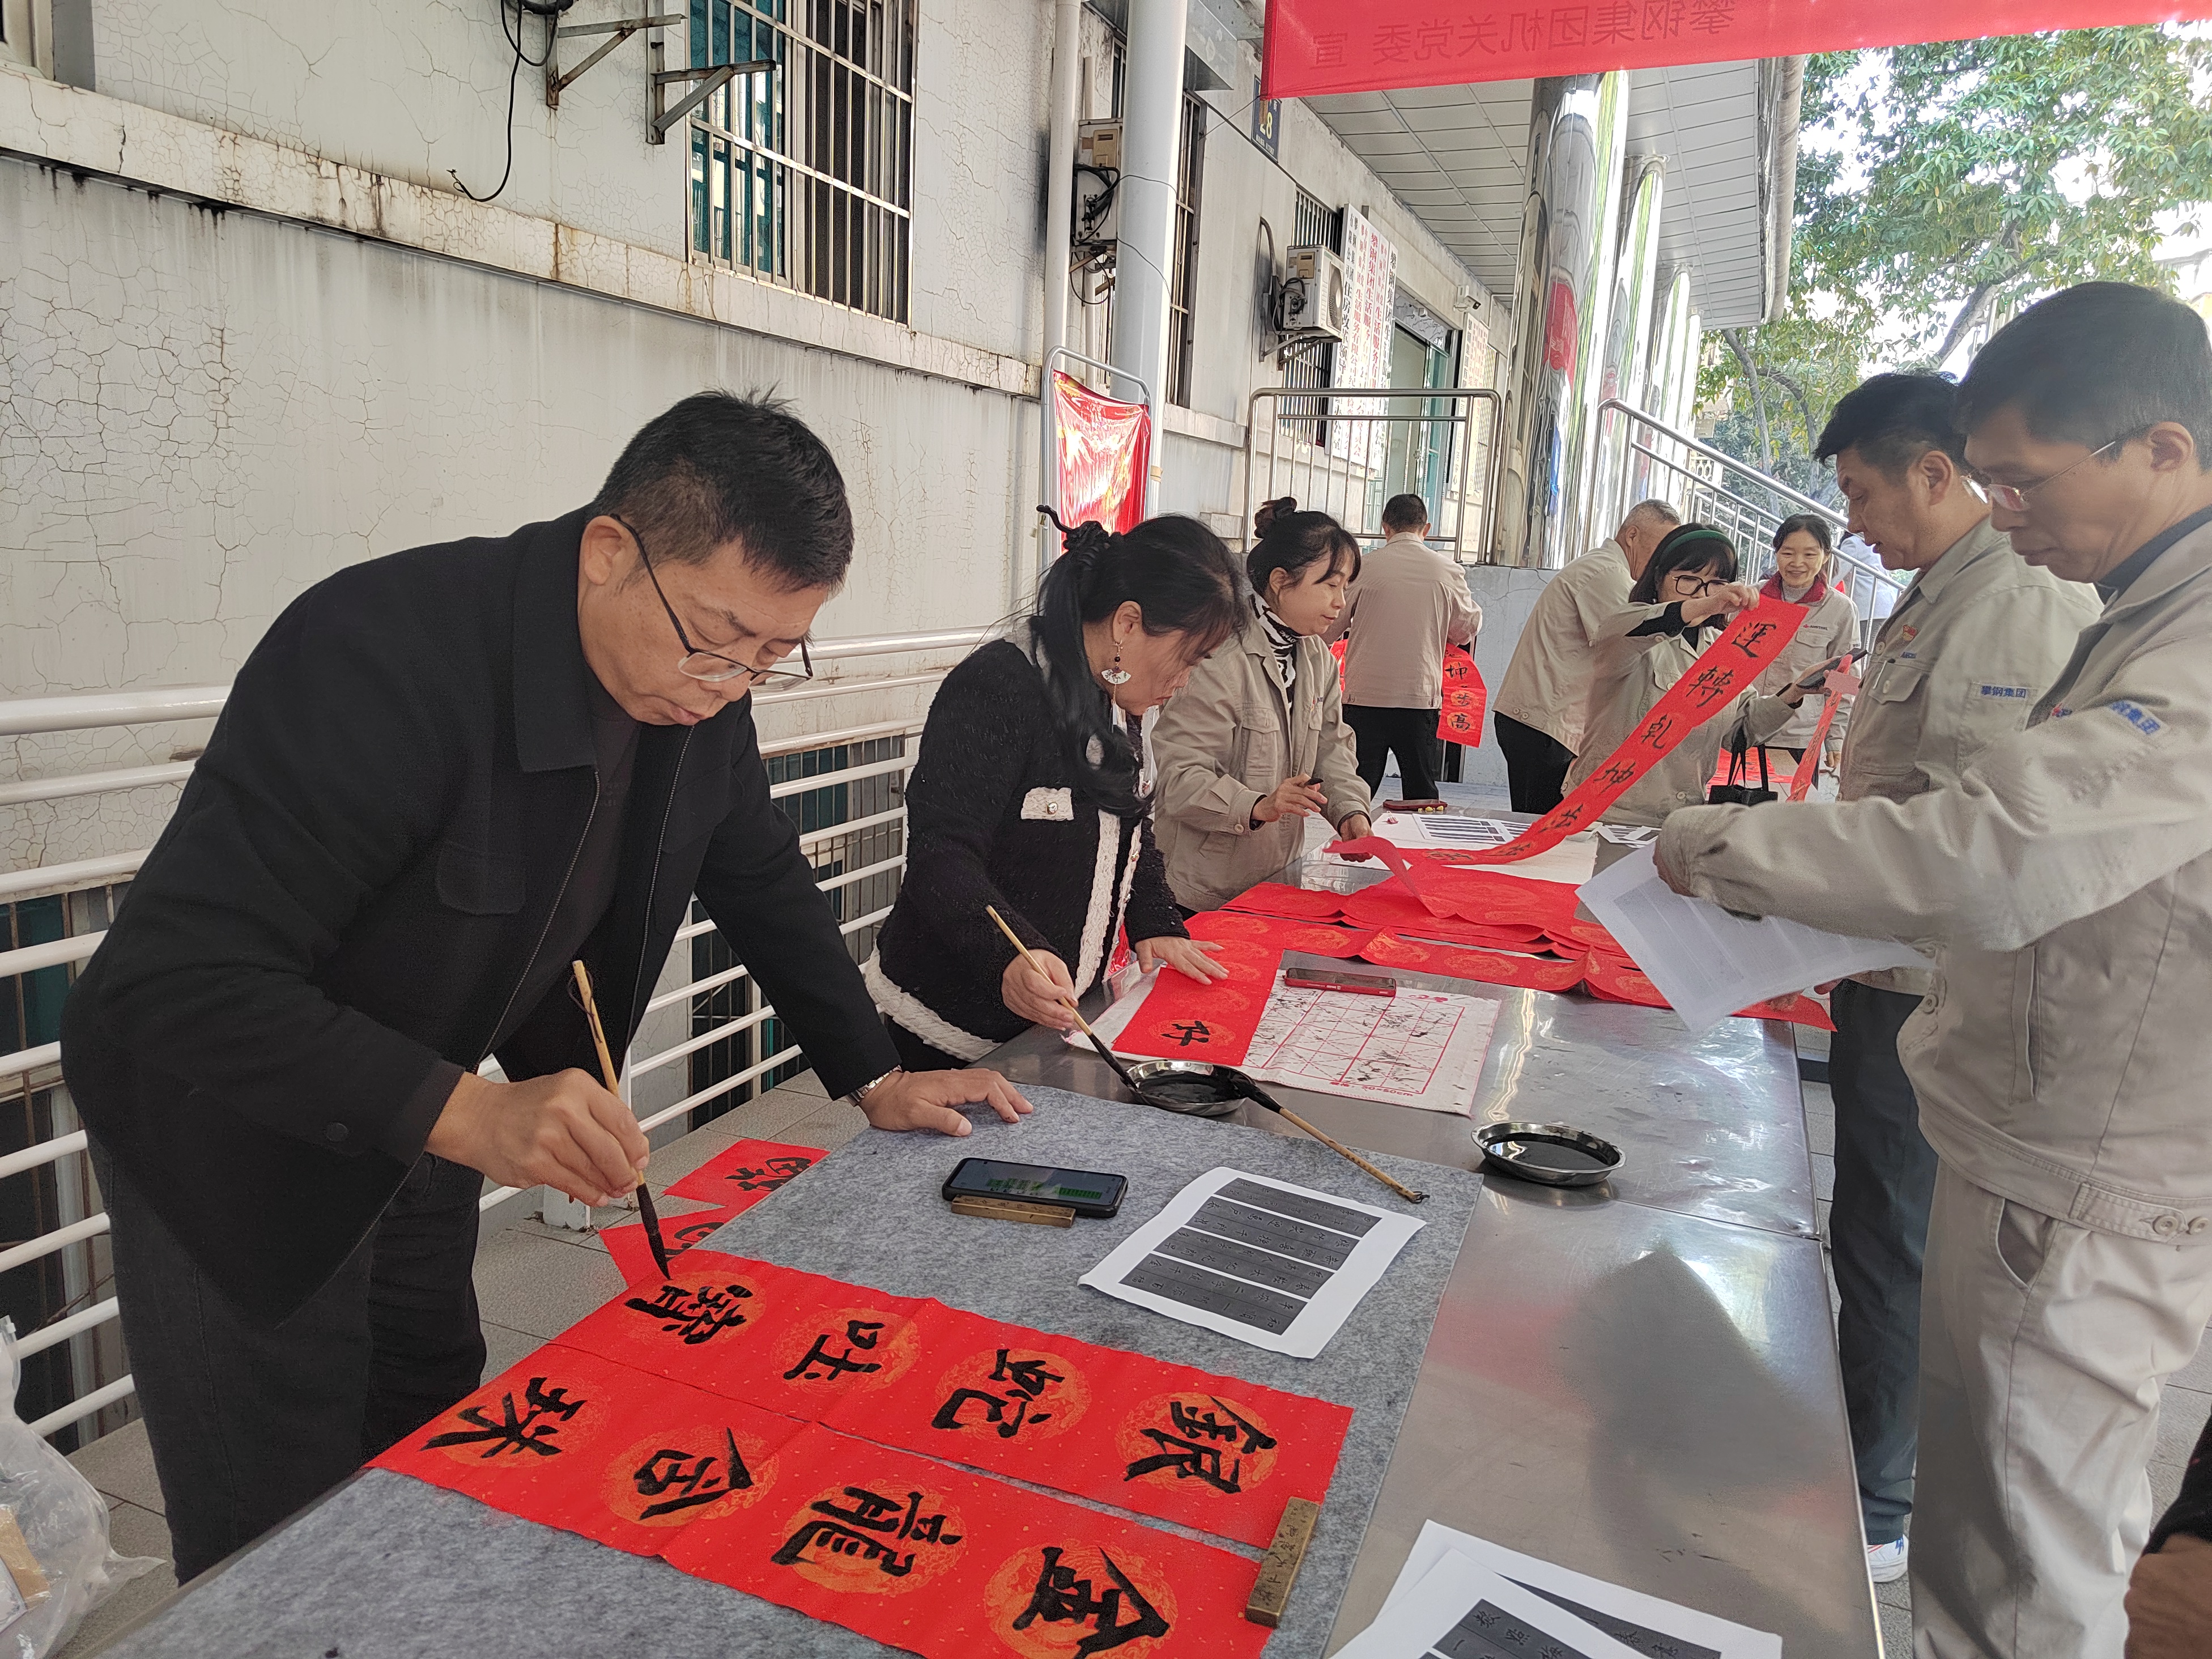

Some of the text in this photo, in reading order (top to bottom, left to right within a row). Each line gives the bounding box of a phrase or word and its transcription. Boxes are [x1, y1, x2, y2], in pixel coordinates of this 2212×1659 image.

[1445, 662, 1472, 731] 坤步高
[1980, 686, 2027, 699] 攀钢集团
[425, 1378, 1169, 1658] 金龍含珠
